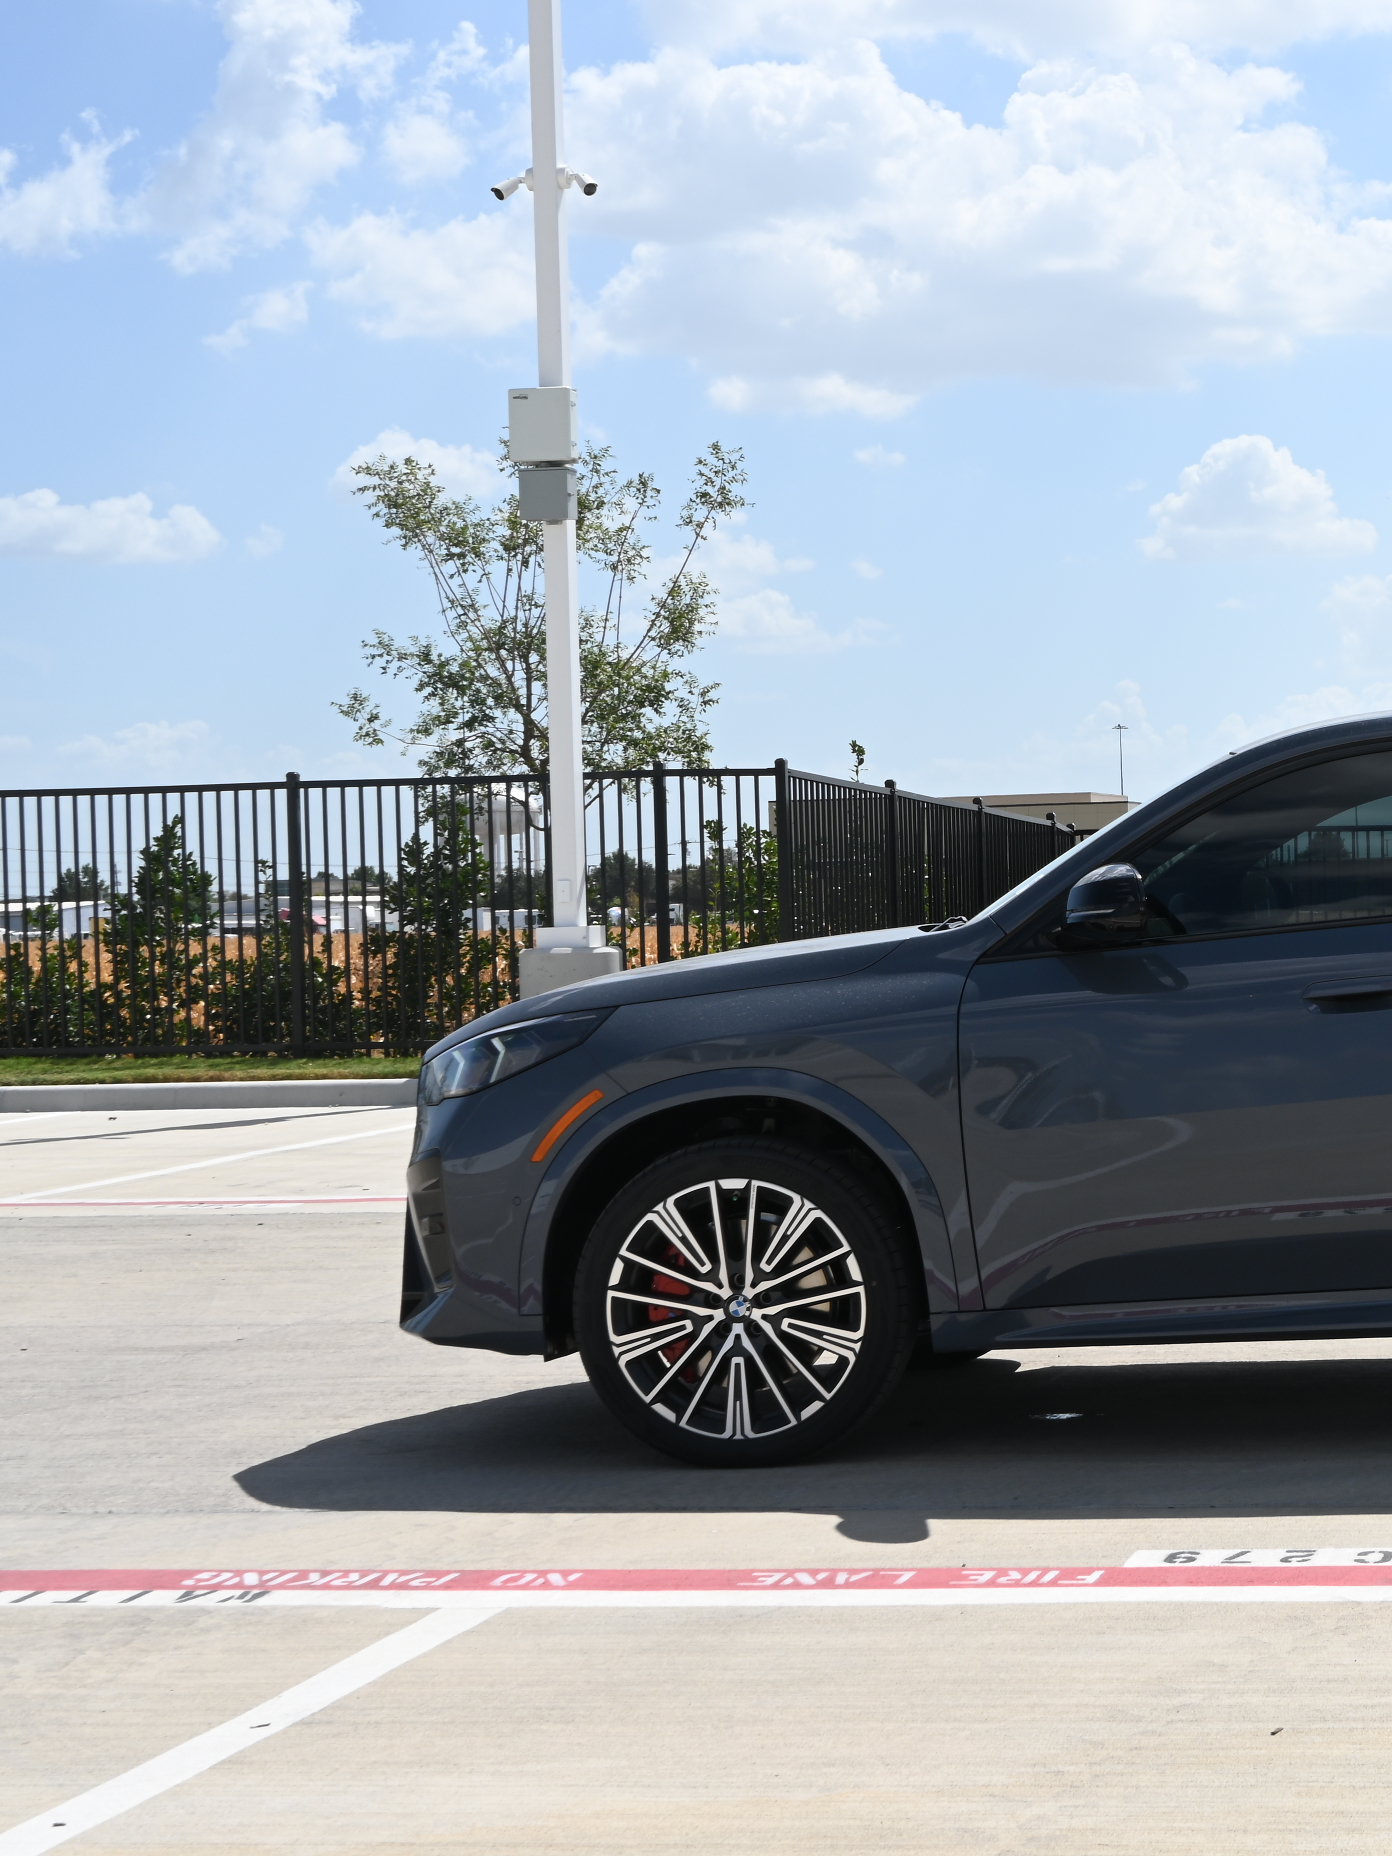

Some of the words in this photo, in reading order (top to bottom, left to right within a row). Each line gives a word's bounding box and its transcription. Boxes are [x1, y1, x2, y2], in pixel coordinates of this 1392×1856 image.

[1163, 1550, 1317, 1564] 279
[181, 1572, 461, 1587] PARKING
[489, 1572, 584, 1587] NO
[736, 1571, 916, 1586] LANE
[950, 1570, 1104, 1585] FIRE
[0, 1590, 272, 1604] WAITI
